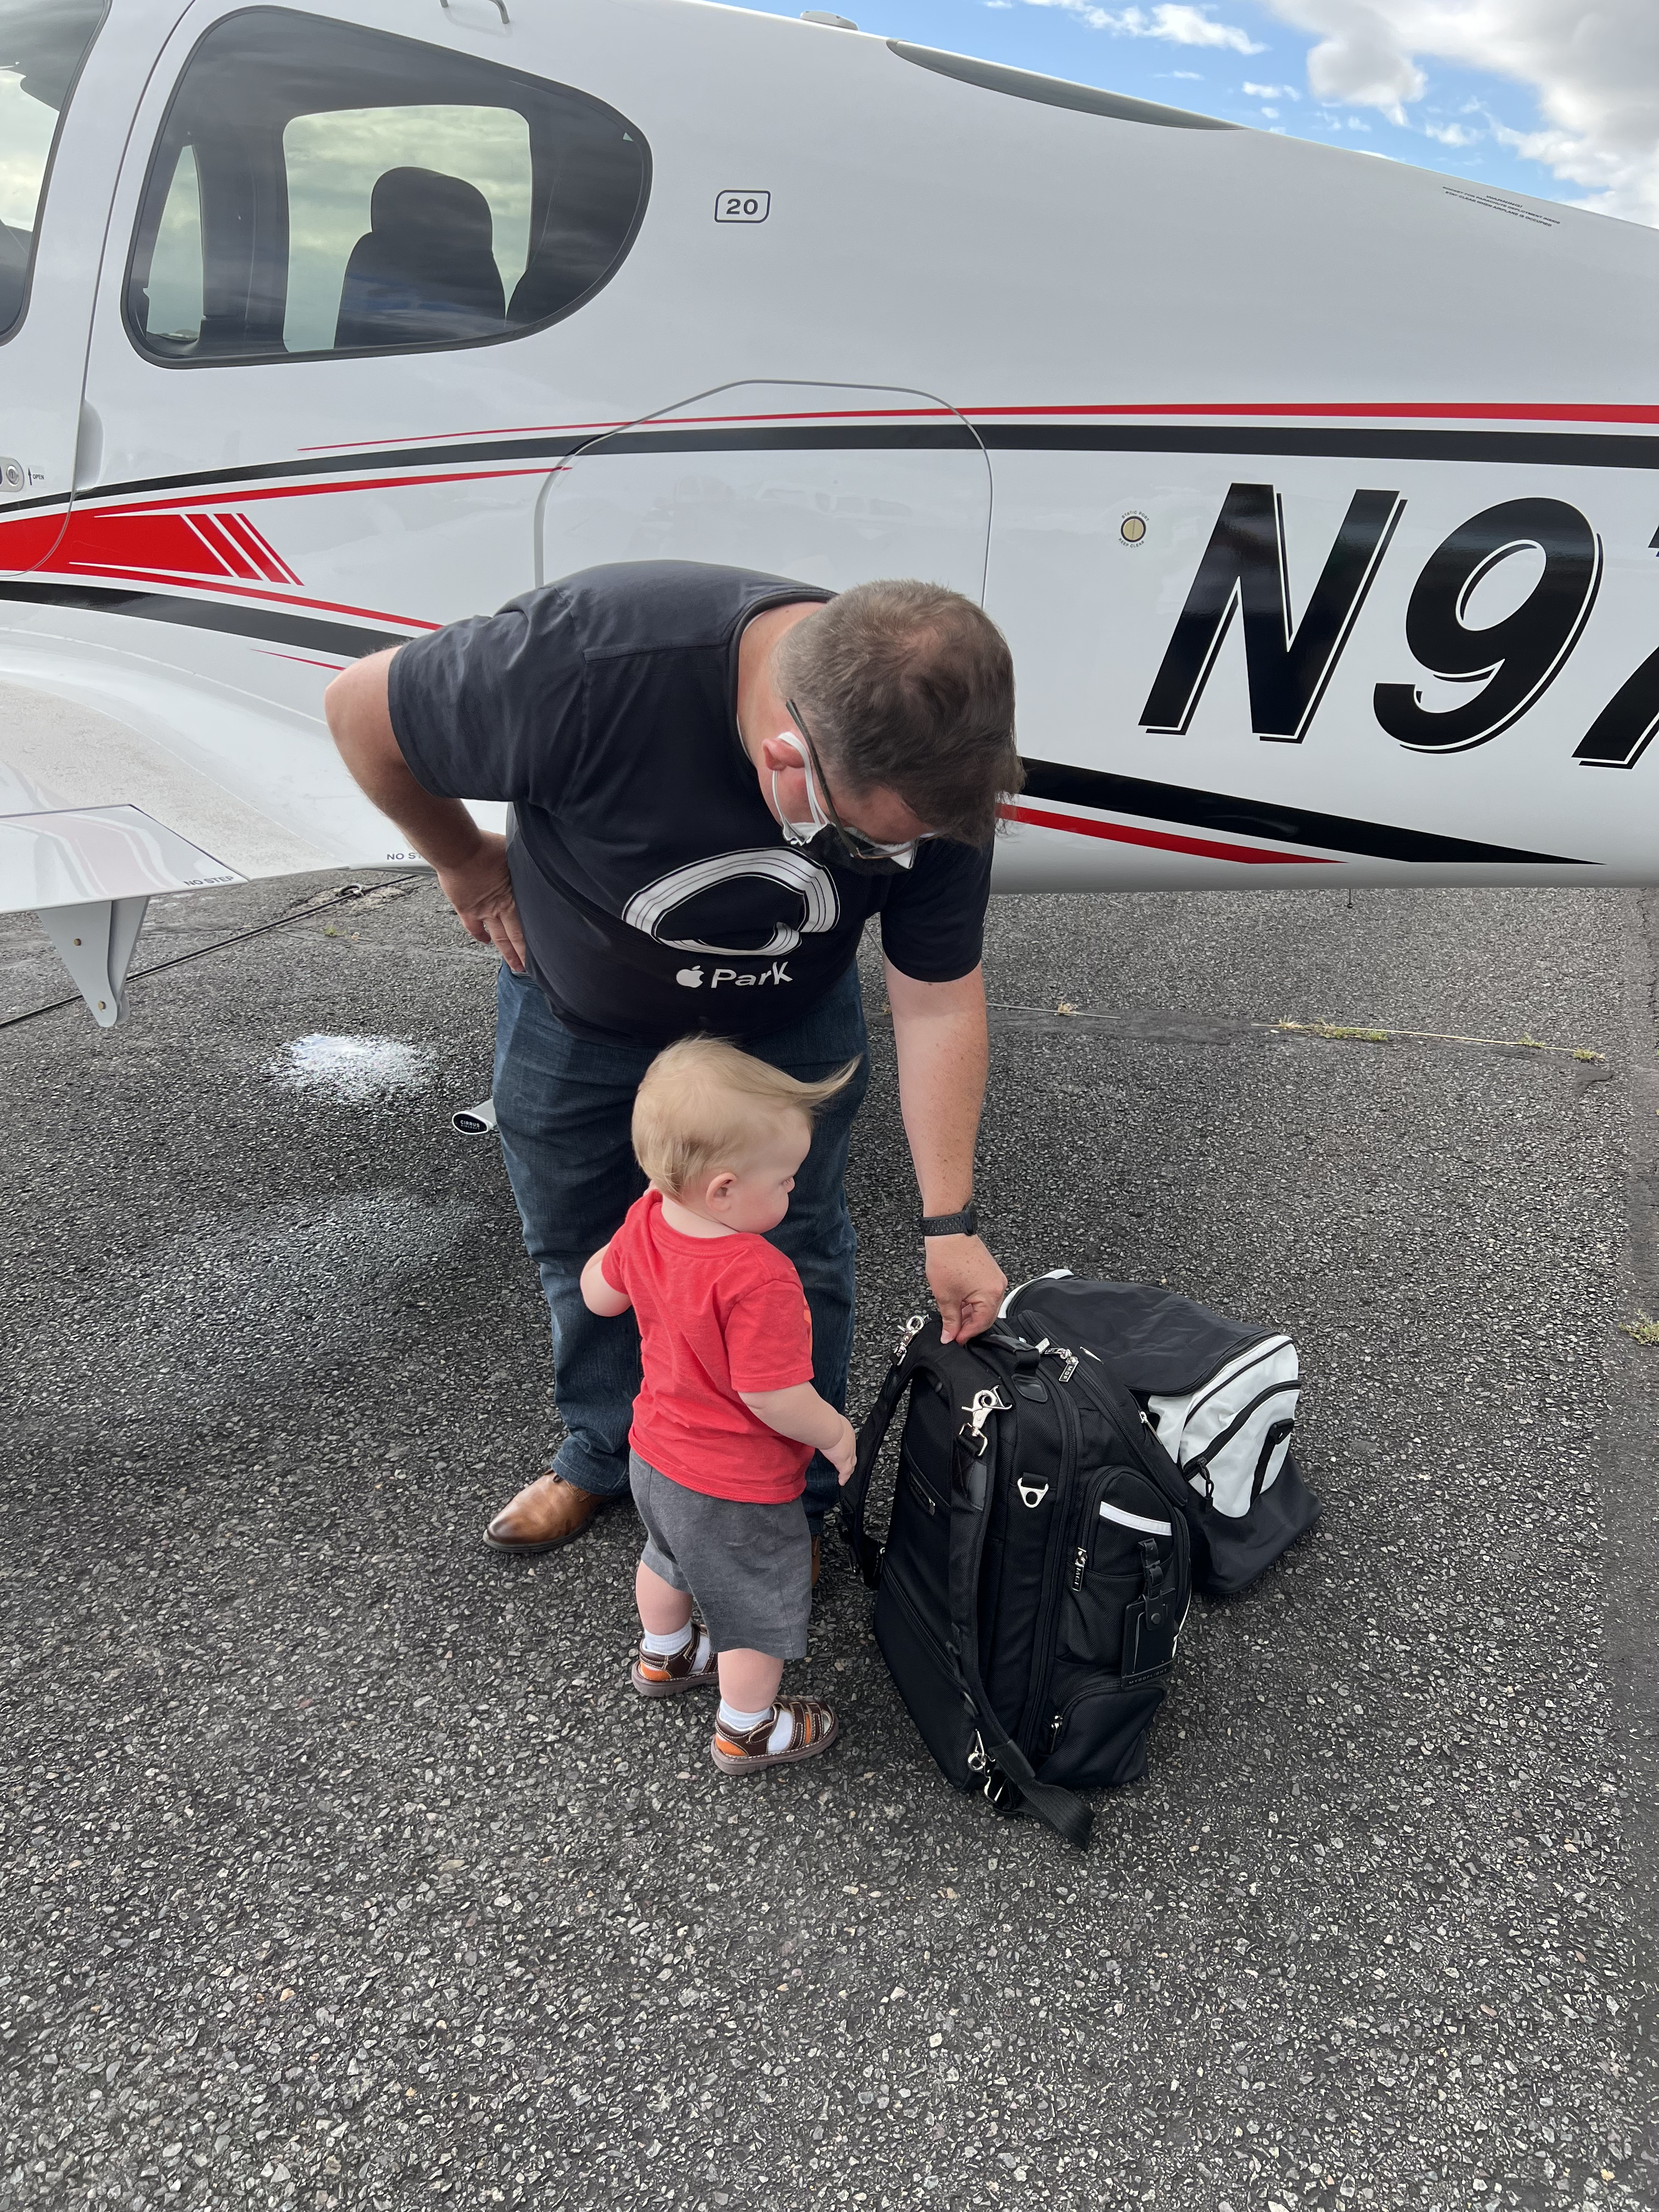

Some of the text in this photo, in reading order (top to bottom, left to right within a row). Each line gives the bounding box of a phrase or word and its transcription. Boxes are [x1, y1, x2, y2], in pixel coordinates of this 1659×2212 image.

[726, 198, 758, 215] 20
[1476, 196, 1506, 207] PARACHUTE
[1507, 206, 1543, 218] DEPLOYMENT
[1486, 195, 1523, 208] WARNING!
[1493, 206, 1518, 216] AIRPLANE
[1525, 216, 1552, 227] OCCUPIED
[1121, 510, 1150, 521] STATIC PORT
[1118, 538, 1145, 548] KEEP CLEAR
[204, 876, 234, 884] STEP
[711, 961, 793, 989] Park
[460, 1120, 480, 1128] CIRRUS
